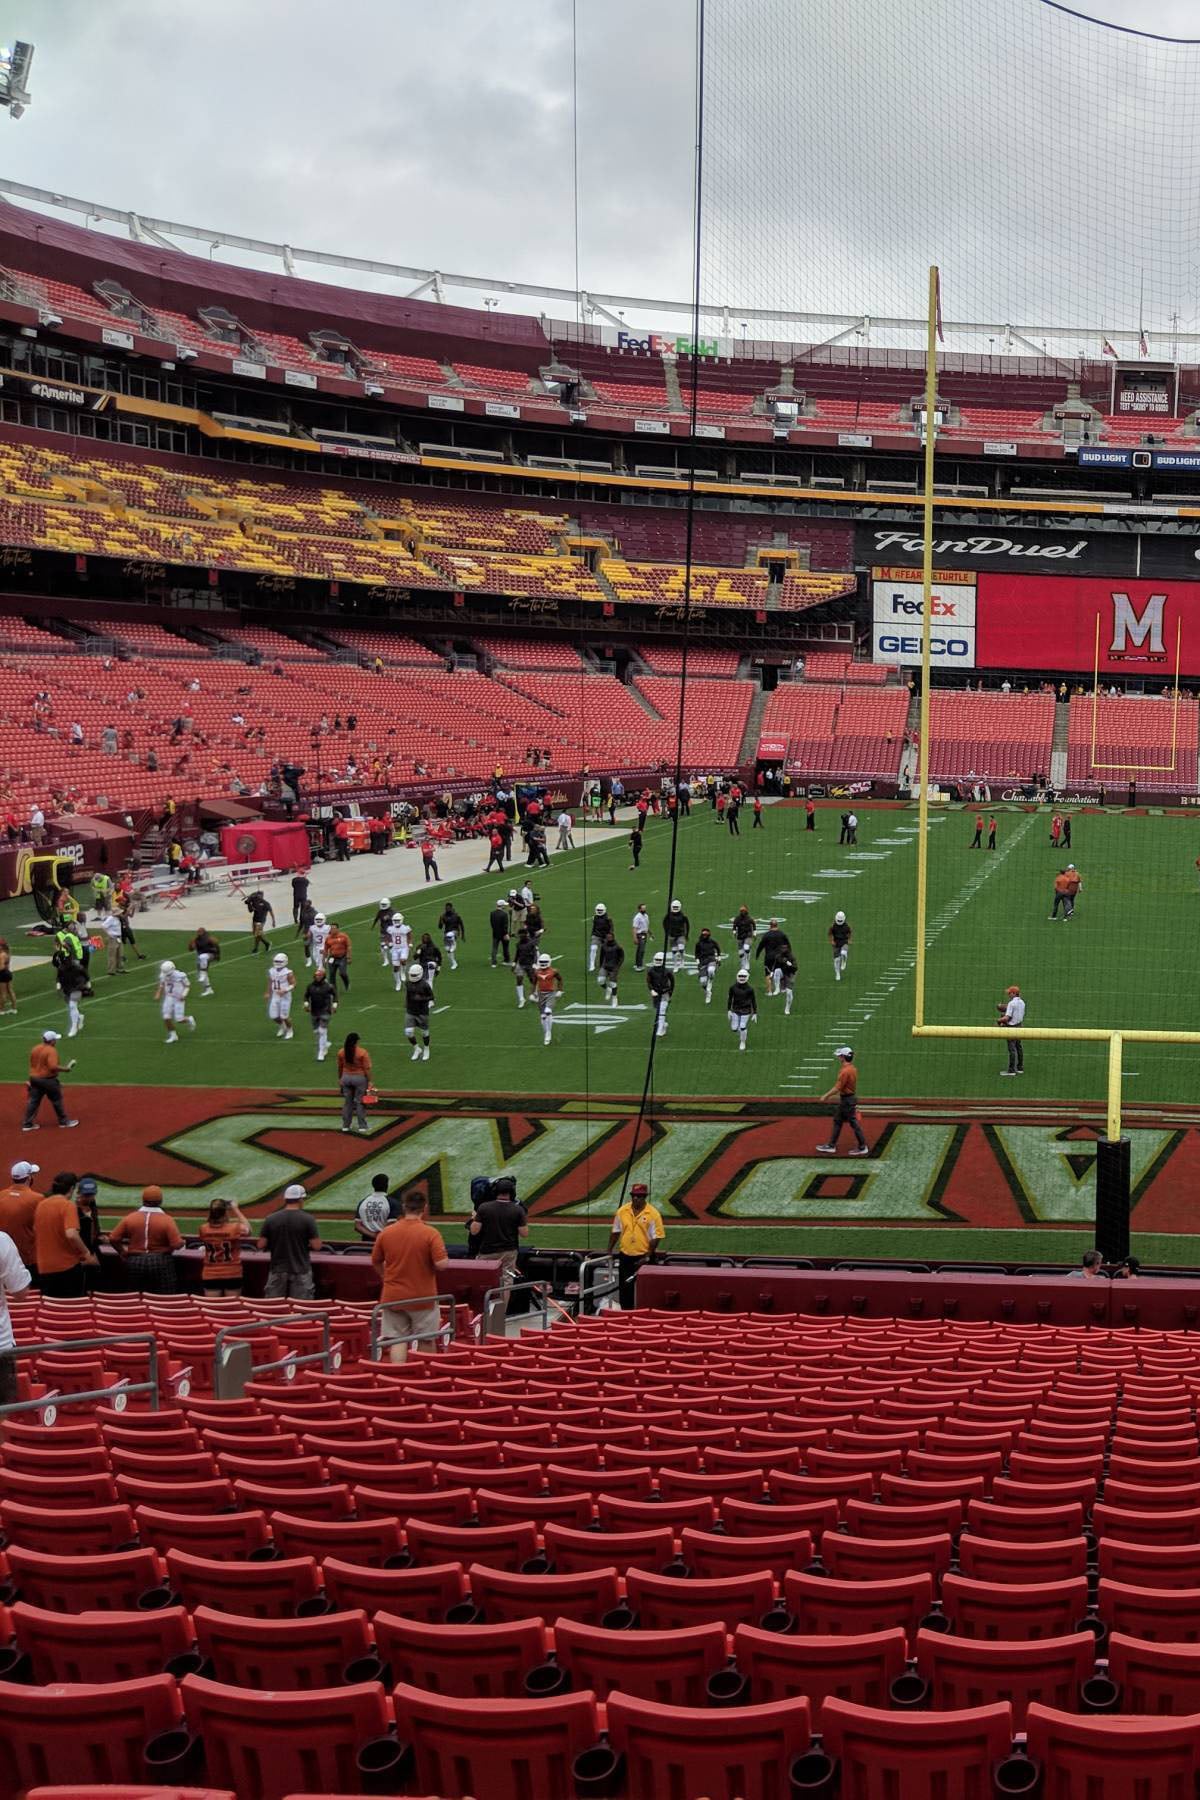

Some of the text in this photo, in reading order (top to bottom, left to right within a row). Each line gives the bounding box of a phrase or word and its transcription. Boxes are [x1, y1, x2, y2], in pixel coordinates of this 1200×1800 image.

[40, 384, 84, 404] Ameritel
[1120, 392, 1169, 403] NEED ASSISTANCE
[1083, 453, 1127, 463] BUD LIGHT
[1157, 456, 1200, 466] BUD LIGHT
[874, 531, 1088, 559] FanDuel
[893, 594, 957, 616] FedEx
[1109, 592, 1169, 653] M
[879, 636, 969, 656] GEICO
